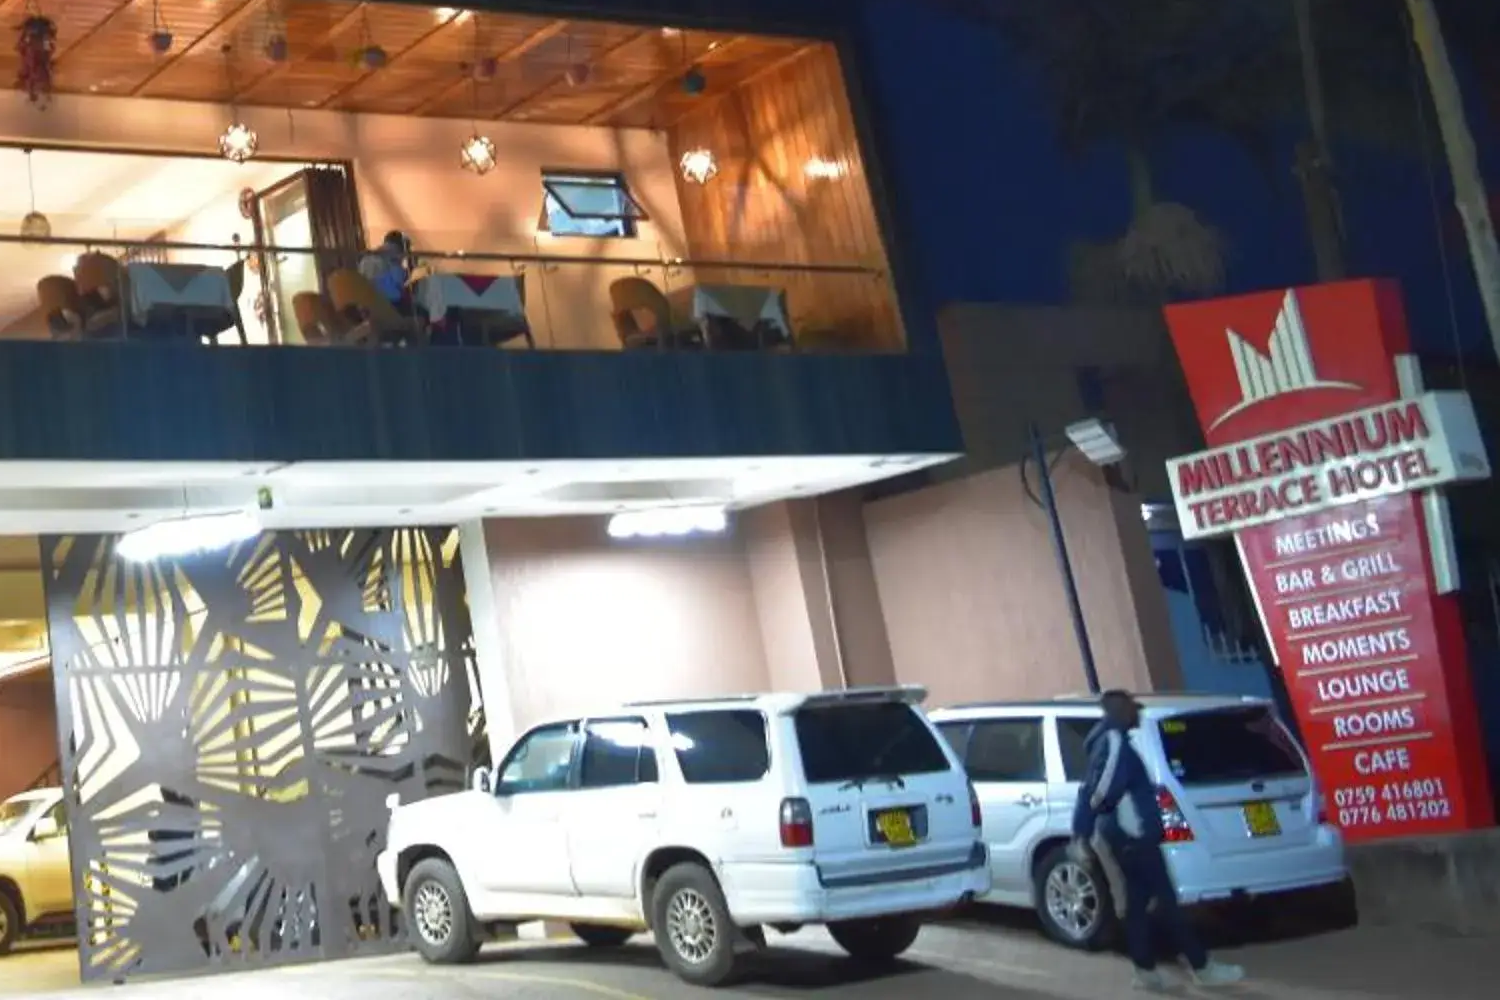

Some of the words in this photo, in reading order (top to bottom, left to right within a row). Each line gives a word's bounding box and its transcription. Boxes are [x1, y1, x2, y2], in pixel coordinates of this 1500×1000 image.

[1177, 402, 1430, 497] MILLENNIUM
[1187, 475, 1322, 529] TERRACE
[1327, 448, 1439, 497] HOTEL
[1275, 513, 1380, 556] MEETINGS
[1275, 568, 1316, 593] BAR
[1321, 564, 1336, 585] &
[1341, 551, 1401, 581] GRILL
[1288, 589, 1401, 629] BREAKFAST
[1302, 628, 1411, 665] MOMENTS
[1317, 668, 1410, 701] LOUNGE
[1333, 707, 1415, 738] ROOMS
[1354, 747, 1411, 774] CAFE
[1334, 785, 1375, 807] 0759
[1381, 777, 1443, 800] 416801
[1339, 806, 1381, 827] 0776
[1386, 799, 1450, 822] 481202
